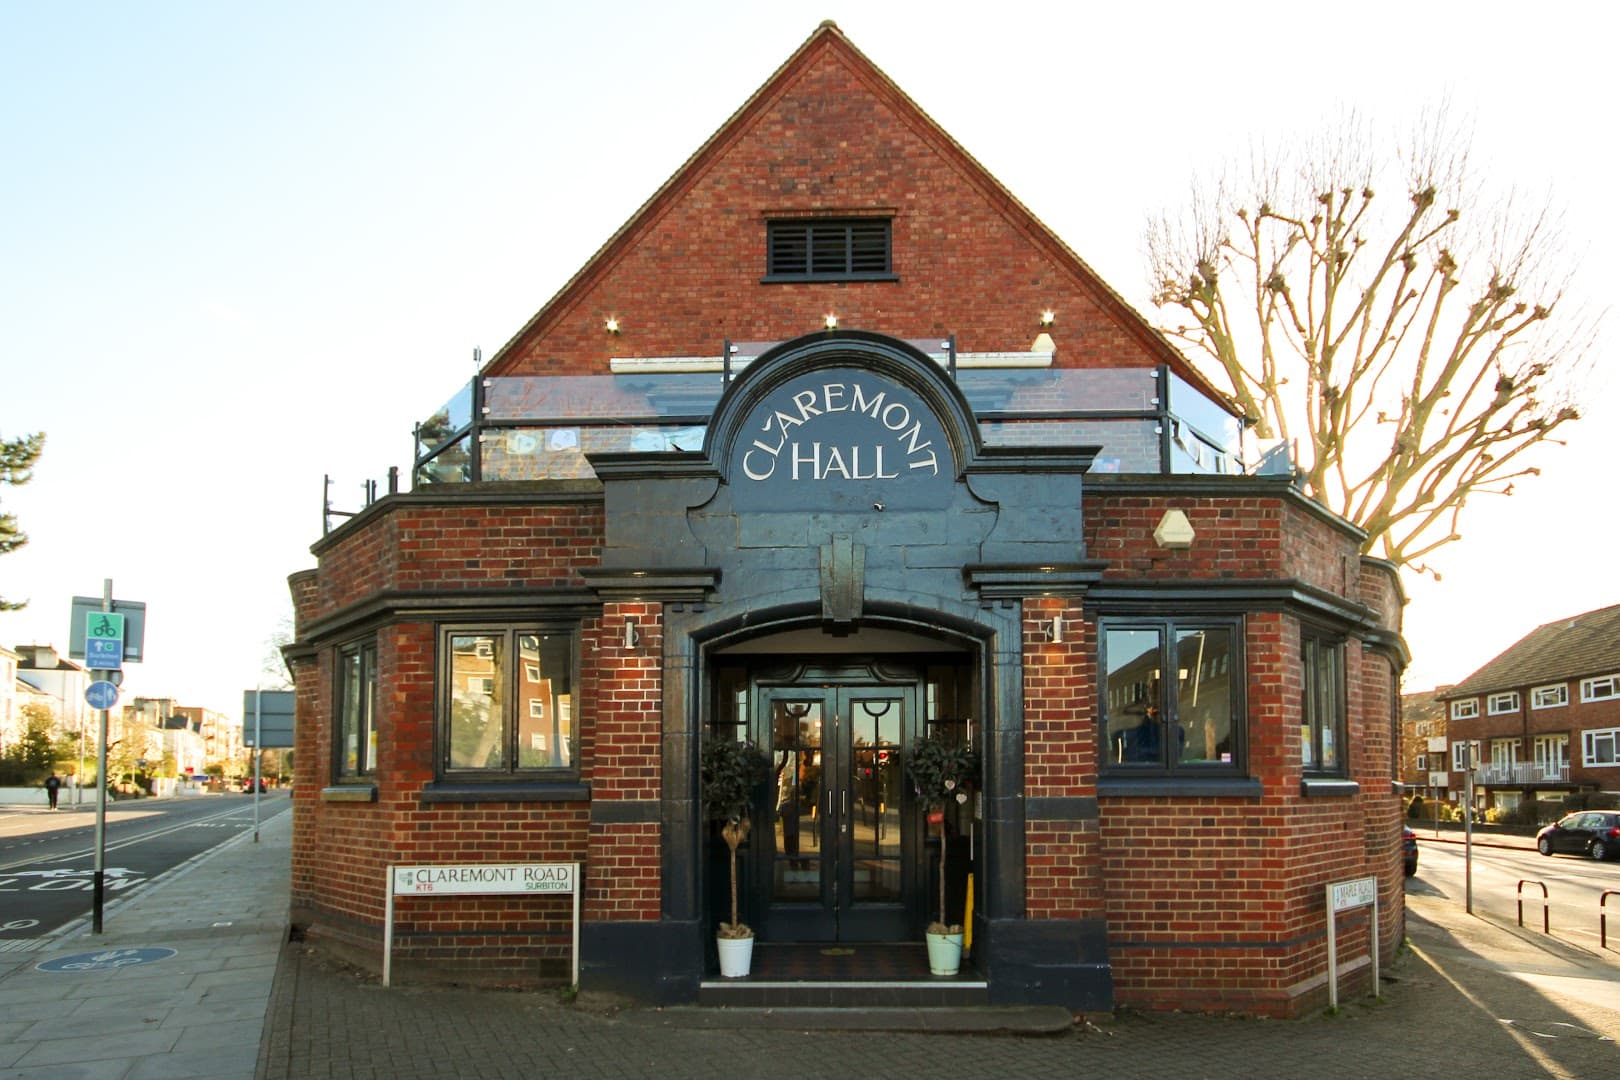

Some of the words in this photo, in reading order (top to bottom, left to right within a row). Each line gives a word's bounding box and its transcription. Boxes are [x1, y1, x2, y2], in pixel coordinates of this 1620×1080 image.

[743, 383, 939, 481] CLAREMONT
[792, 442, 899, 480] HALL
[416, 868, 517, 884] CLAREMONT
[524, 867, 568, 881] ROAD
[415, 884, 433, 892] KT6
[525, 882, 568, 891] SURBITON
